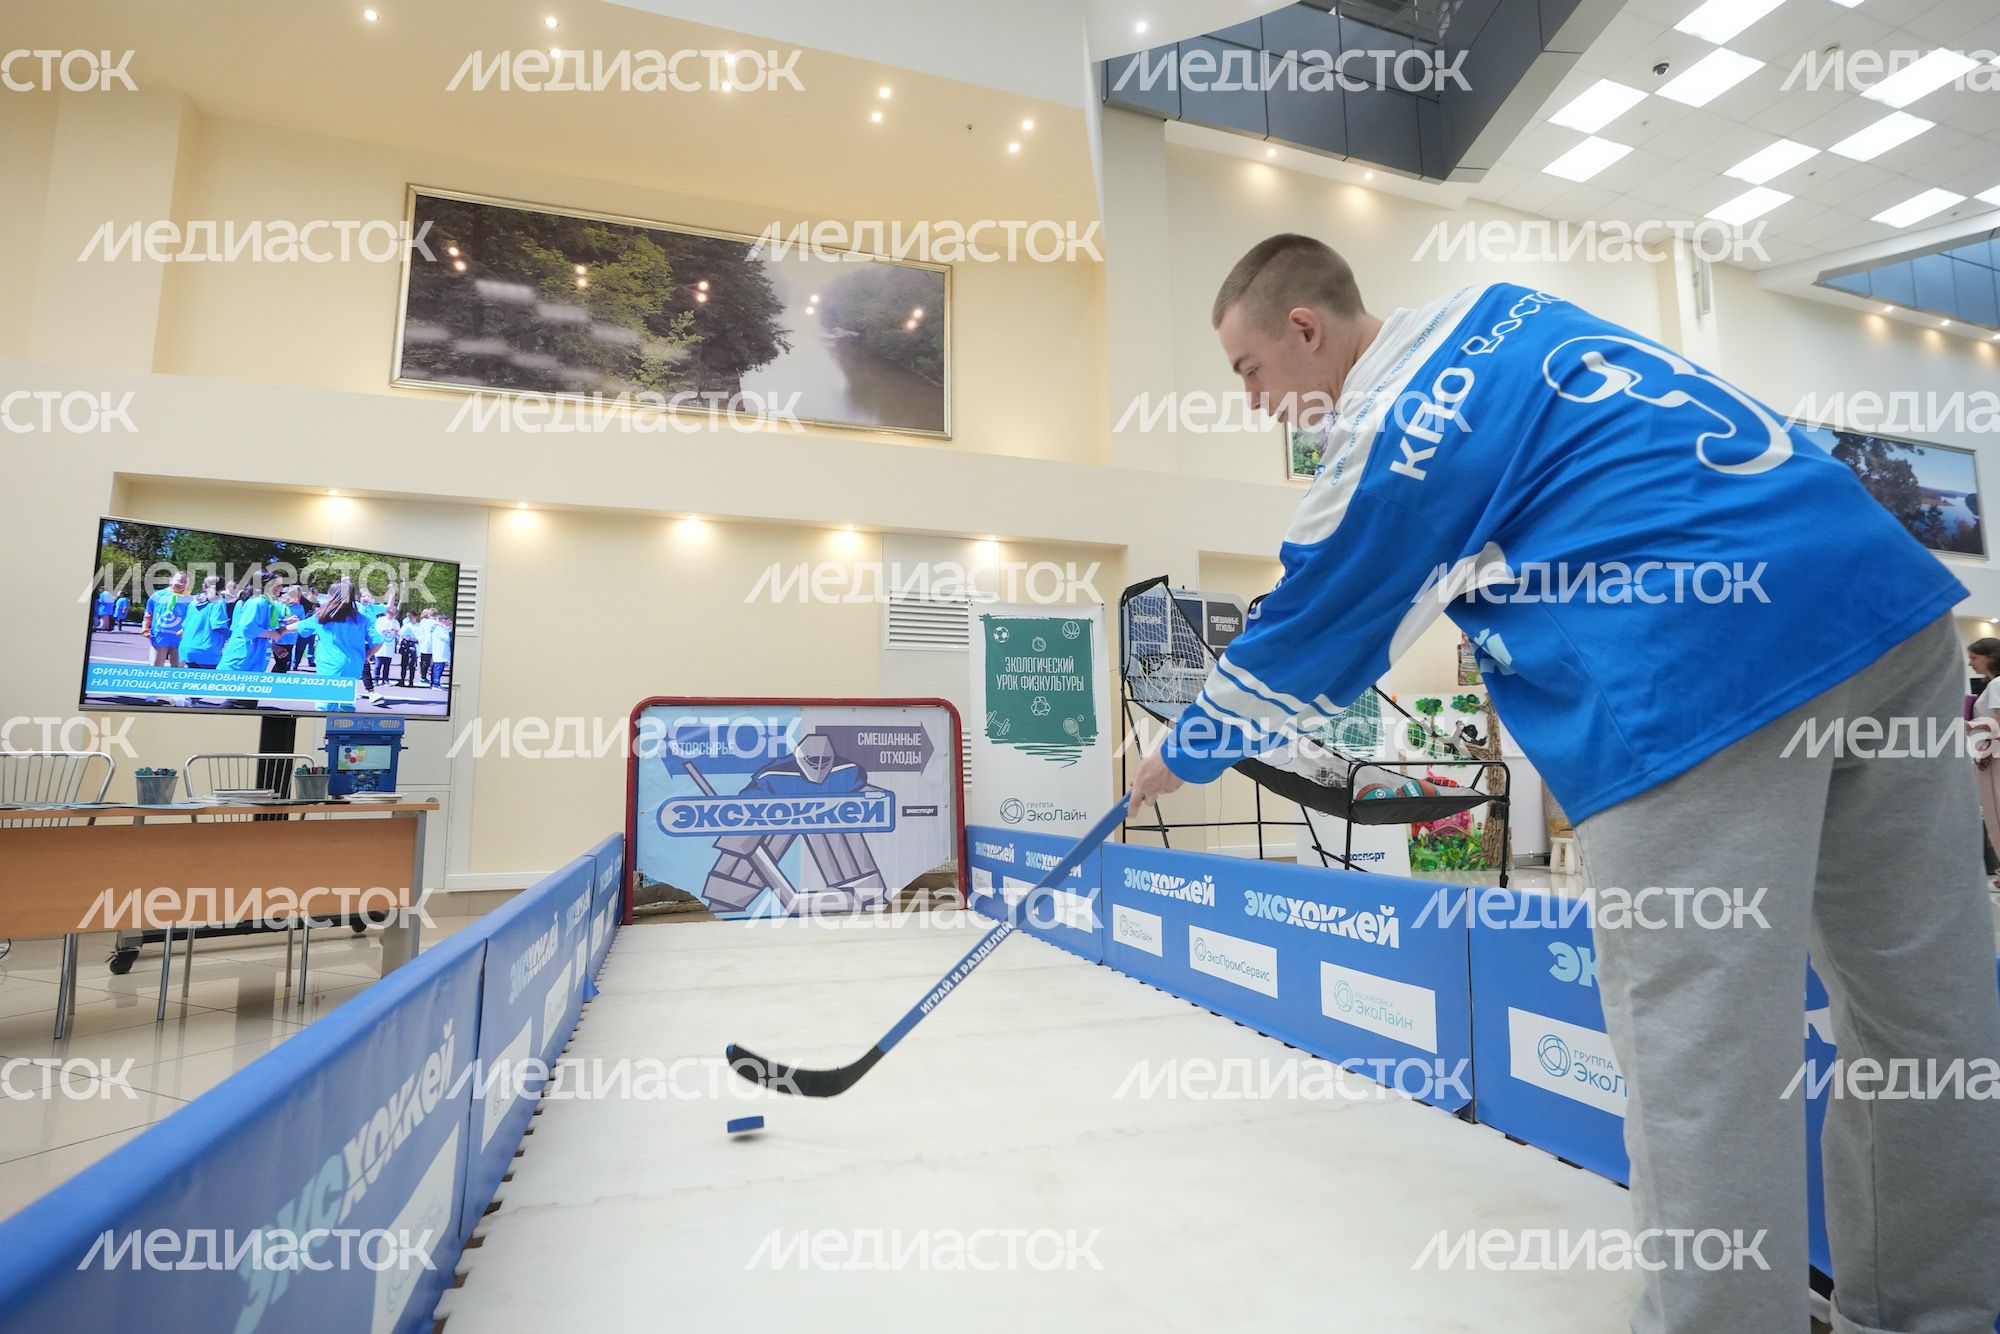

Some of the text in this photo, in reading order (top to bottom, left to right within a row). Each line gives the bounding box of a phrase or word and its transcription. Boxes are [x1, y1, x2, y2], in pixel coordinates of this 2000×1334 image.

[1389, 367, 1475, 481] КПО
[1005, 656, 1074, 673] ЭКОЛОГИЧЕСКИЙ
[91, 678, 273, 694] НА ПЛОЩАДКЕ РЖАВСКОЙ СОШ
[92, 667, 353, 688] ФИНАЛЬНЫЕ СОРЕВНОВАНИЯ 20 МАЯ 2022 ГОДА
[996, 674, 1084, 691] УРОК ФИЗКУЛЬТУРЫ
[858, 732, 922, 746] СМЕШАННЫЕ
[672, 741, 736, 756] ВТОРСЫРЬЕ
[880, 751, 922, 765] ОТХОДЫ
[1026, 809, 1087, 821] ЭкоЛайн
[920, 920, 1014, 1014] ИГРАЙ И РАЗДЕЛЯЙ
[1206, 950, 1271, 982] ЭкоПромСервис
[1355, 999, 1414, 1031] ЭкоЛайн
[1573, 1050, 1614, 1071] ГРУППА
